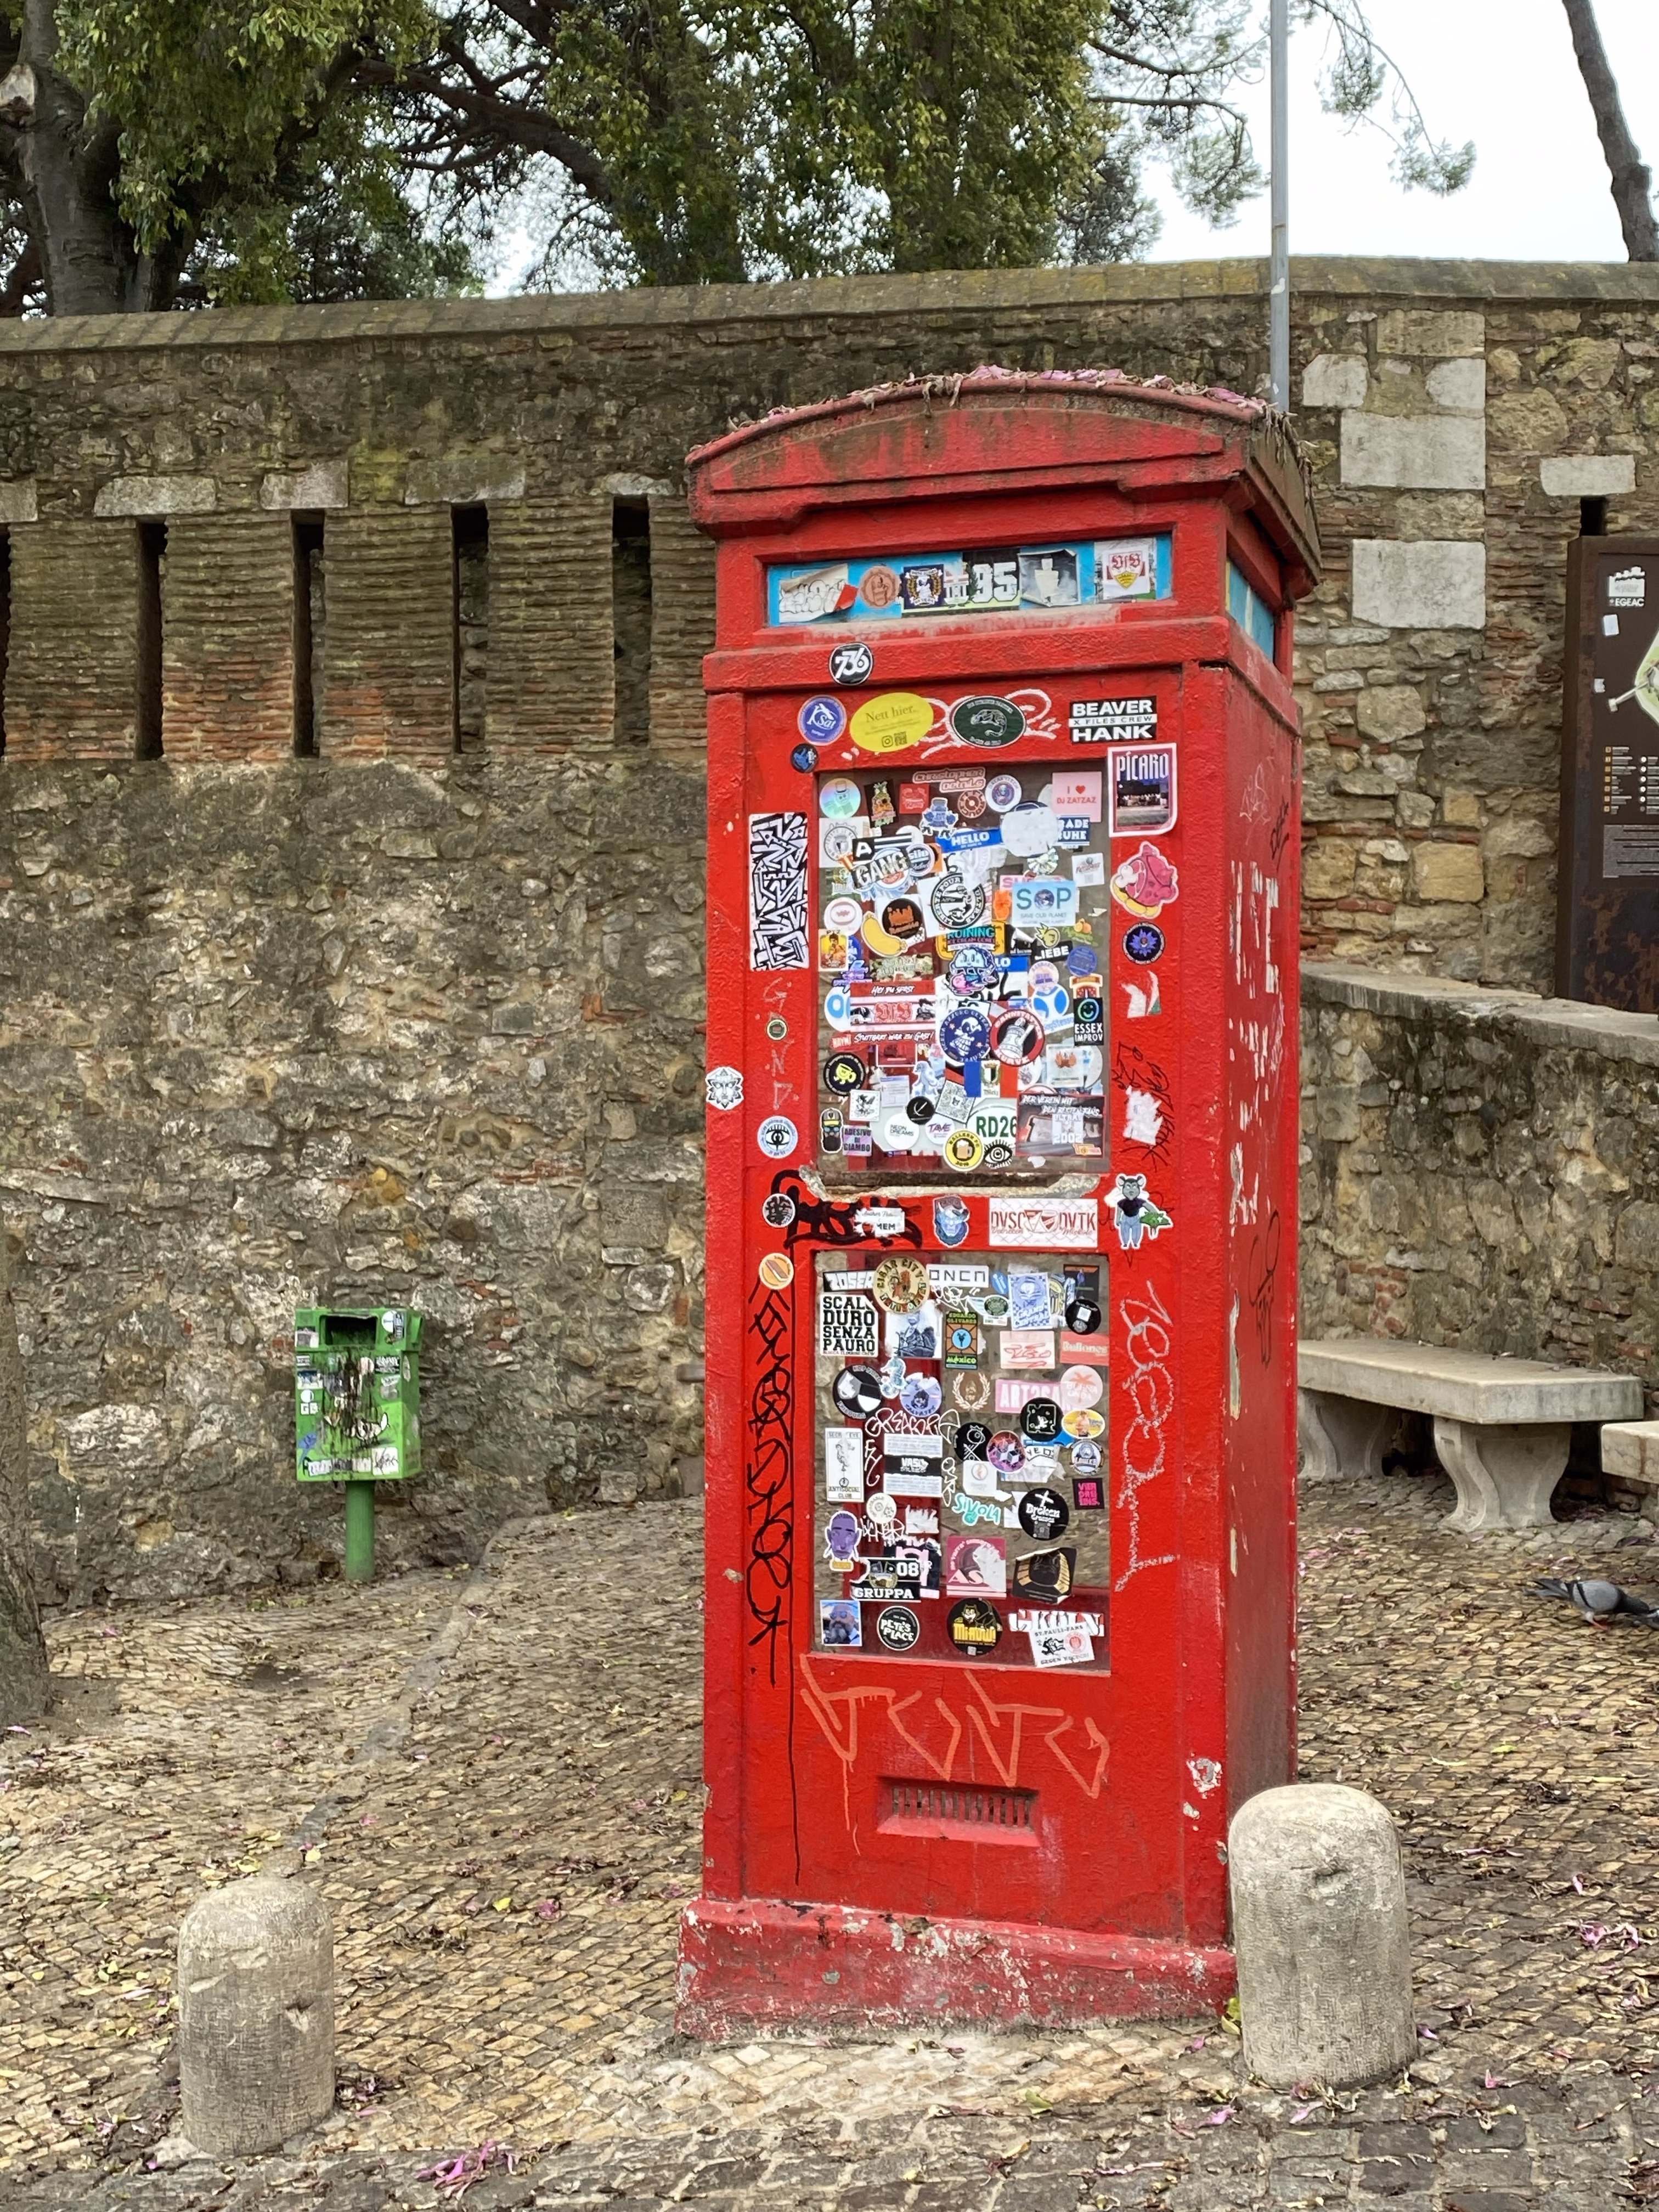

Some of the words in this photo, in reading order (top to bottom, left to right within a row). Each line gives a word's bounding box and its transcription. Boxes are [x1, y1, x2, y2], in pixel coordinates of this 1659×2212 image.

[1615, 598, 1645, 607] EGEAC
[1073, 699, 1153, 716] BEAVER
[866, 710, 888, 723] Nett
[1073, 725, 1153, 742] HANK
[1116, 751, 1169, 782] PÍCARO
[1067, 786, 1070, 794] I
[951, 832, 989, 846] HELLO
[856, 851, 909, 886] GANG
[1074, 1023, 1103, 1034] ESSEX
[1074, 1033, 1103, 1042] IMPROV
[1053, 1133, 1082, 1144] 2002
[844, 1143, 870, 1152] GIAMBO
[1059, 1212, 1096, 1231] DVTK
[902, 1259, 924, 1279] CITY
[823, 1310, 875, 1326] DURO
[823, 1325, 875, 1339] SENZA
[823, 1339, 875, 1351] PAURO
[896, 1562, 919, 1577] 08
[854, 1589, 915, 1599] GRUPPA
[881, 1619, 911, 1632] PETE'S
[883, 1628, 914, 1641] PLACE
